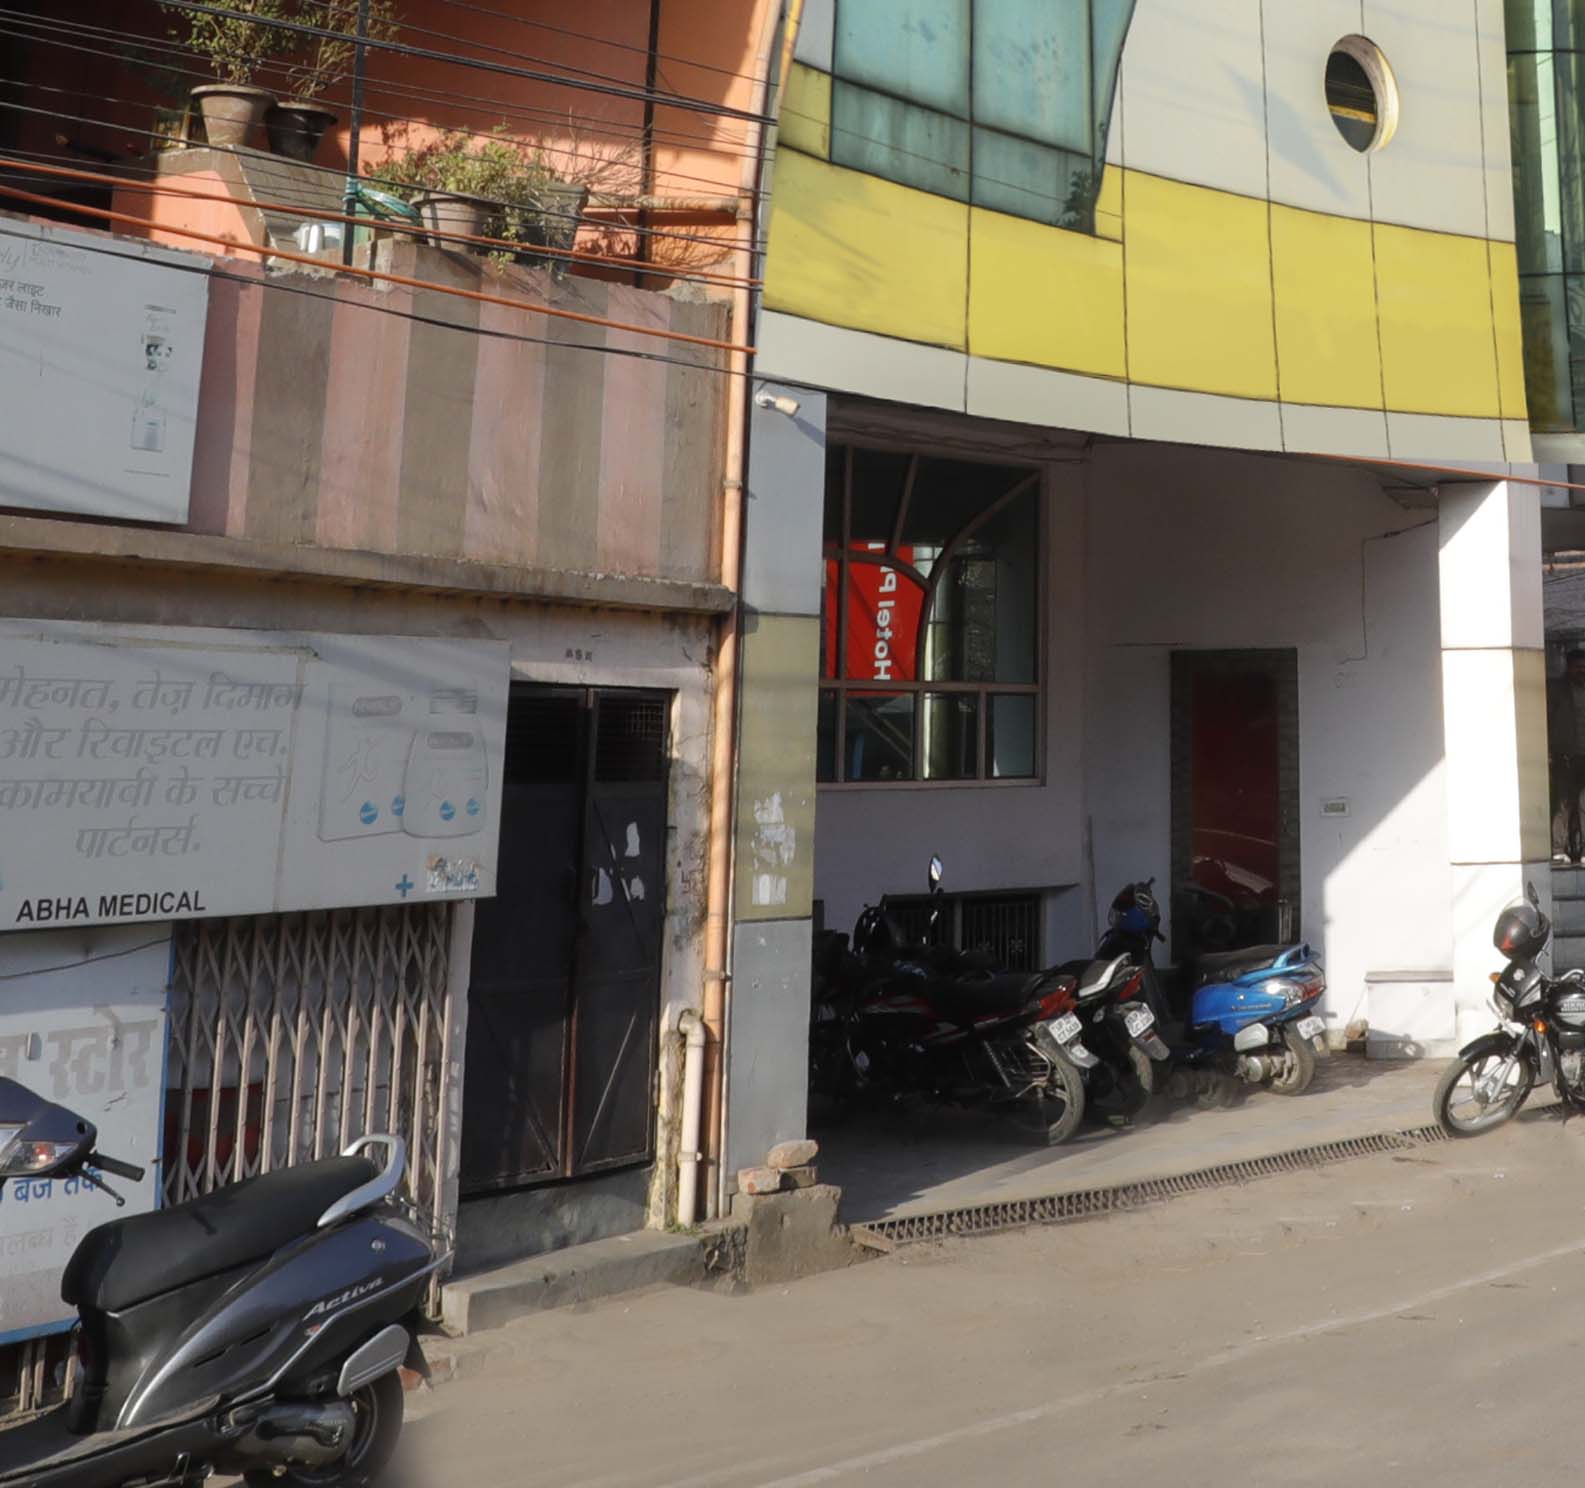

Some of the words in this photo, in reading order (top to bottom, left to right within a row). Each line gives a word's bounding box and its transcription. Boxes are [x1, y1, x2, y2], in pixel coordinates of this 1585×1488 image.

[0, 716, 72, 761] और
[77, 717, 228, 764] रिवाइटल
[165, 765, 205, 806] के
[16, 897, 90, 923] ABHA
[98, 890, 207, 918] MEDICAL
[302, 1277, 384, 1322] Activa
